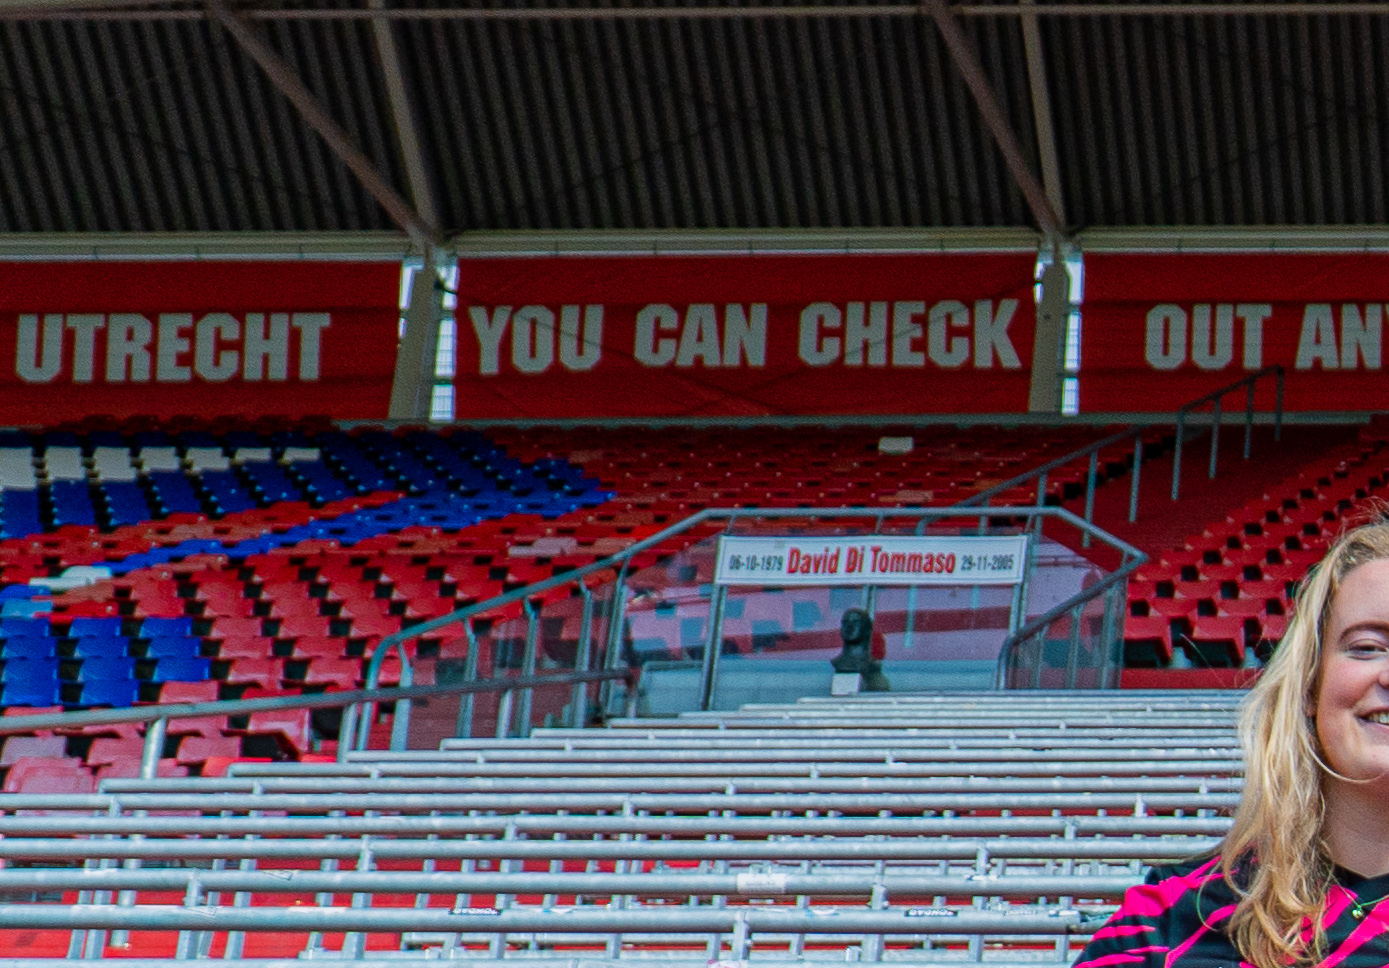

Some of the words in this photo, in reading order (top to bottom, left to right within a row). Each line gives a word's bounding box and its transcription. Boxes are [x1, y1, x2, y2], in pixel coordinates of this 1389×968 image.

[15, 313, 331, 382] UTRECHT
[469, 304, 603, 374] YOU
[634, 303, 767, 367] CAN
[799, 300, 1021, 369] CHECK
[1145, 304, 1273, 369] OUT
[786, 546, 840, 574] David
[844, 545, 865, 573] Di
[871, 545, 957, 574] Tommaso
